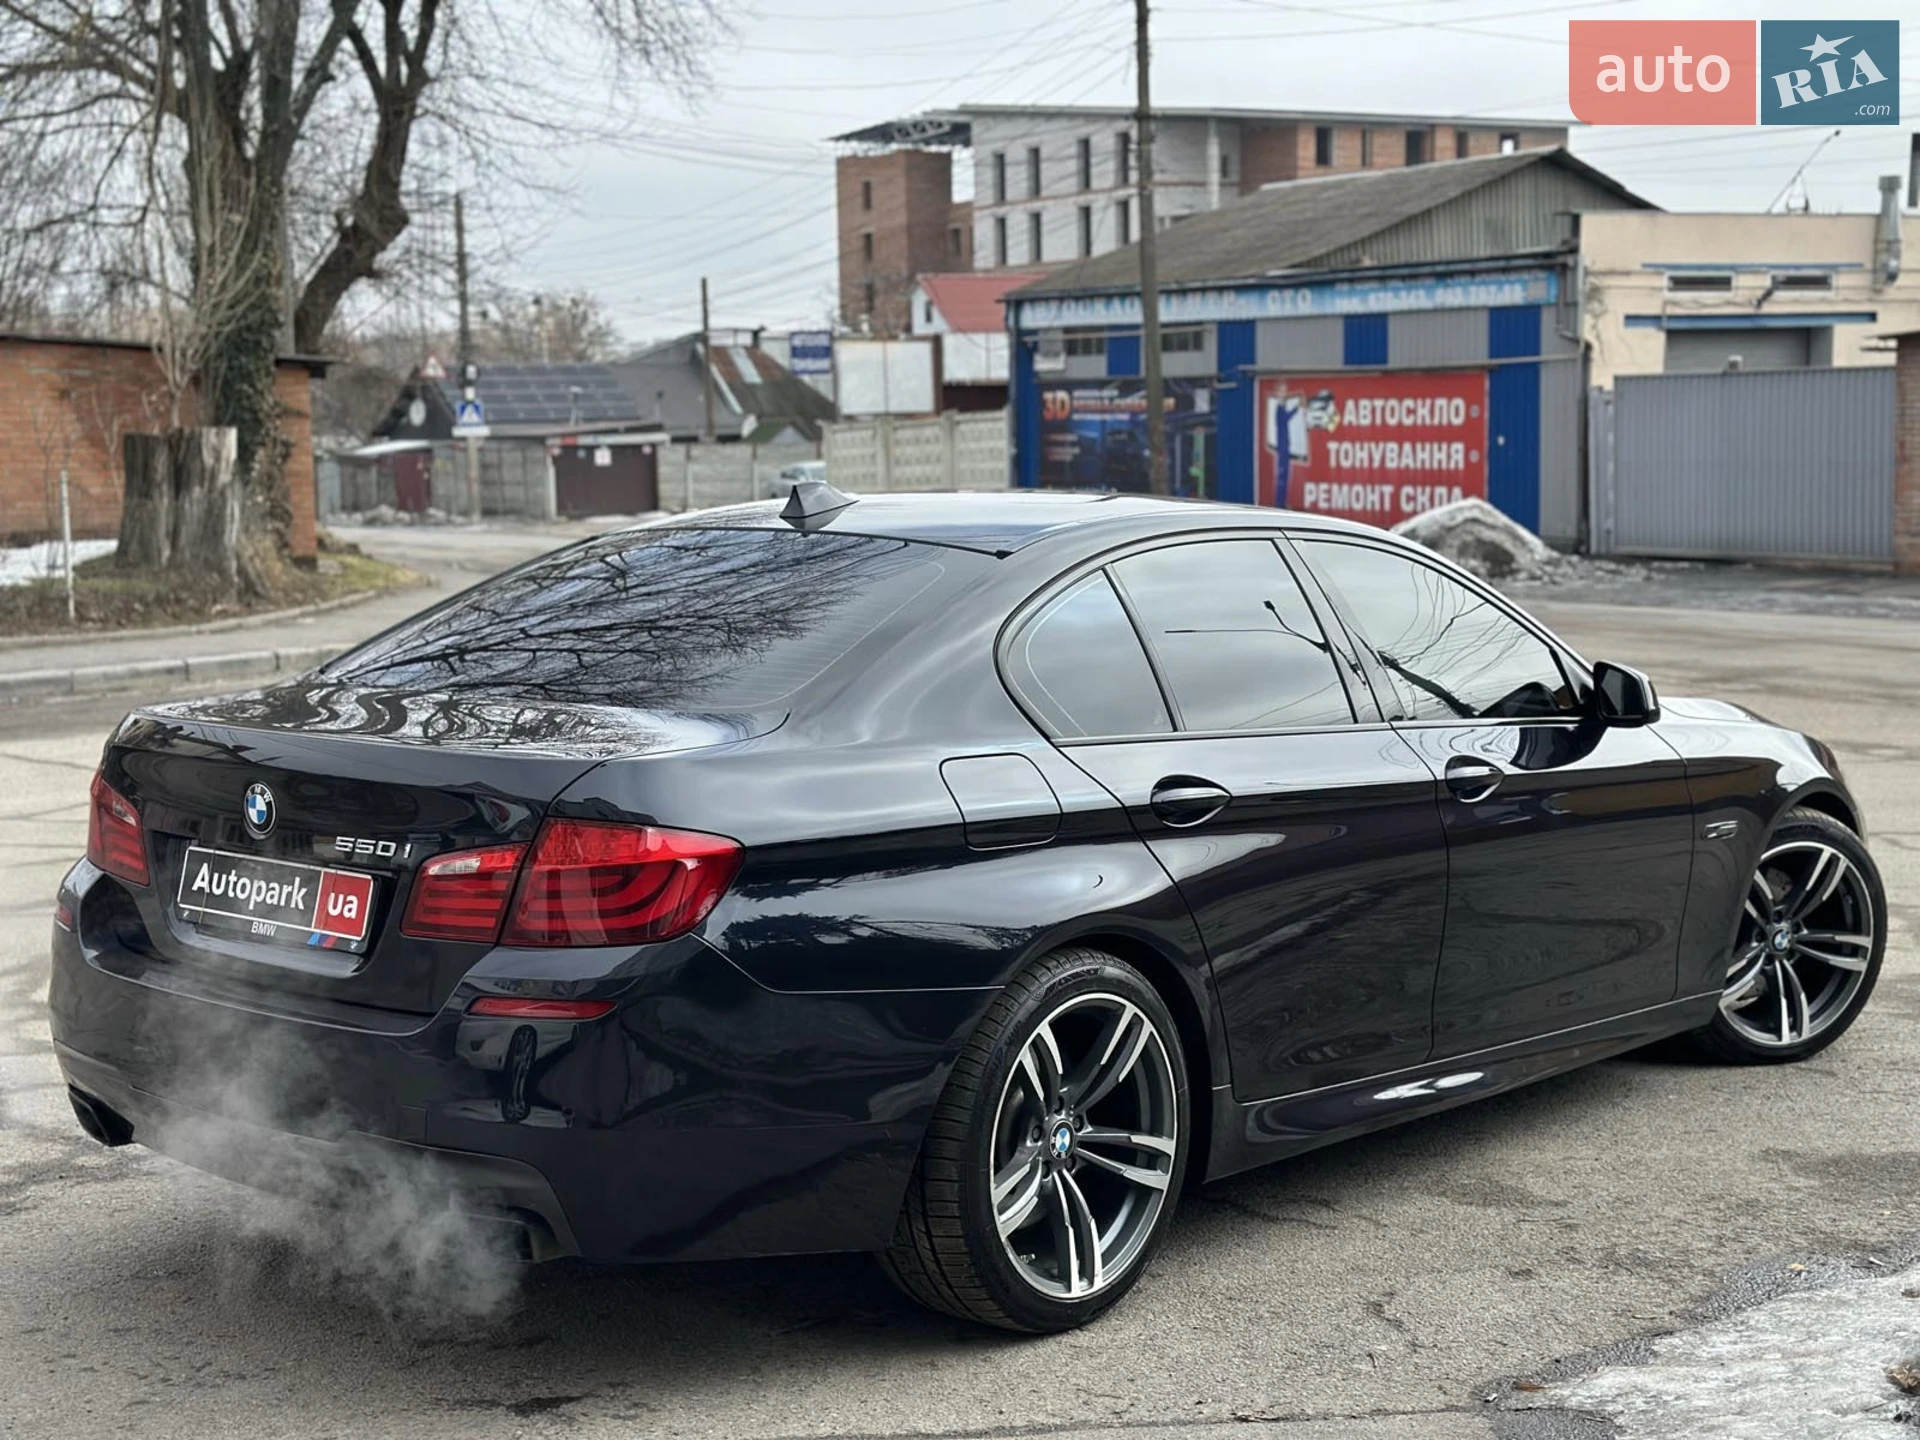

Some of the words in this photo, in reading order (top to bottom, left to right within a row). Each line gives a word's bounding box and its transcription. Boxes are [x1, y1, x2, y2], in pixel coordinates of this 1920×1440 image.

[1042, 389, 1071, 421] 3D
[1343, 397, 1466, 427] АВТОСКЛО
[1327, 441, 1465, 471] ТОНУВАННЯ
[1304, 482, 1394, 512] РЕМОНТ
[191, 862, 308, 911] Autopark
[327, 890, 359, 919] ua
[251, 921, 277, 937] BMW
